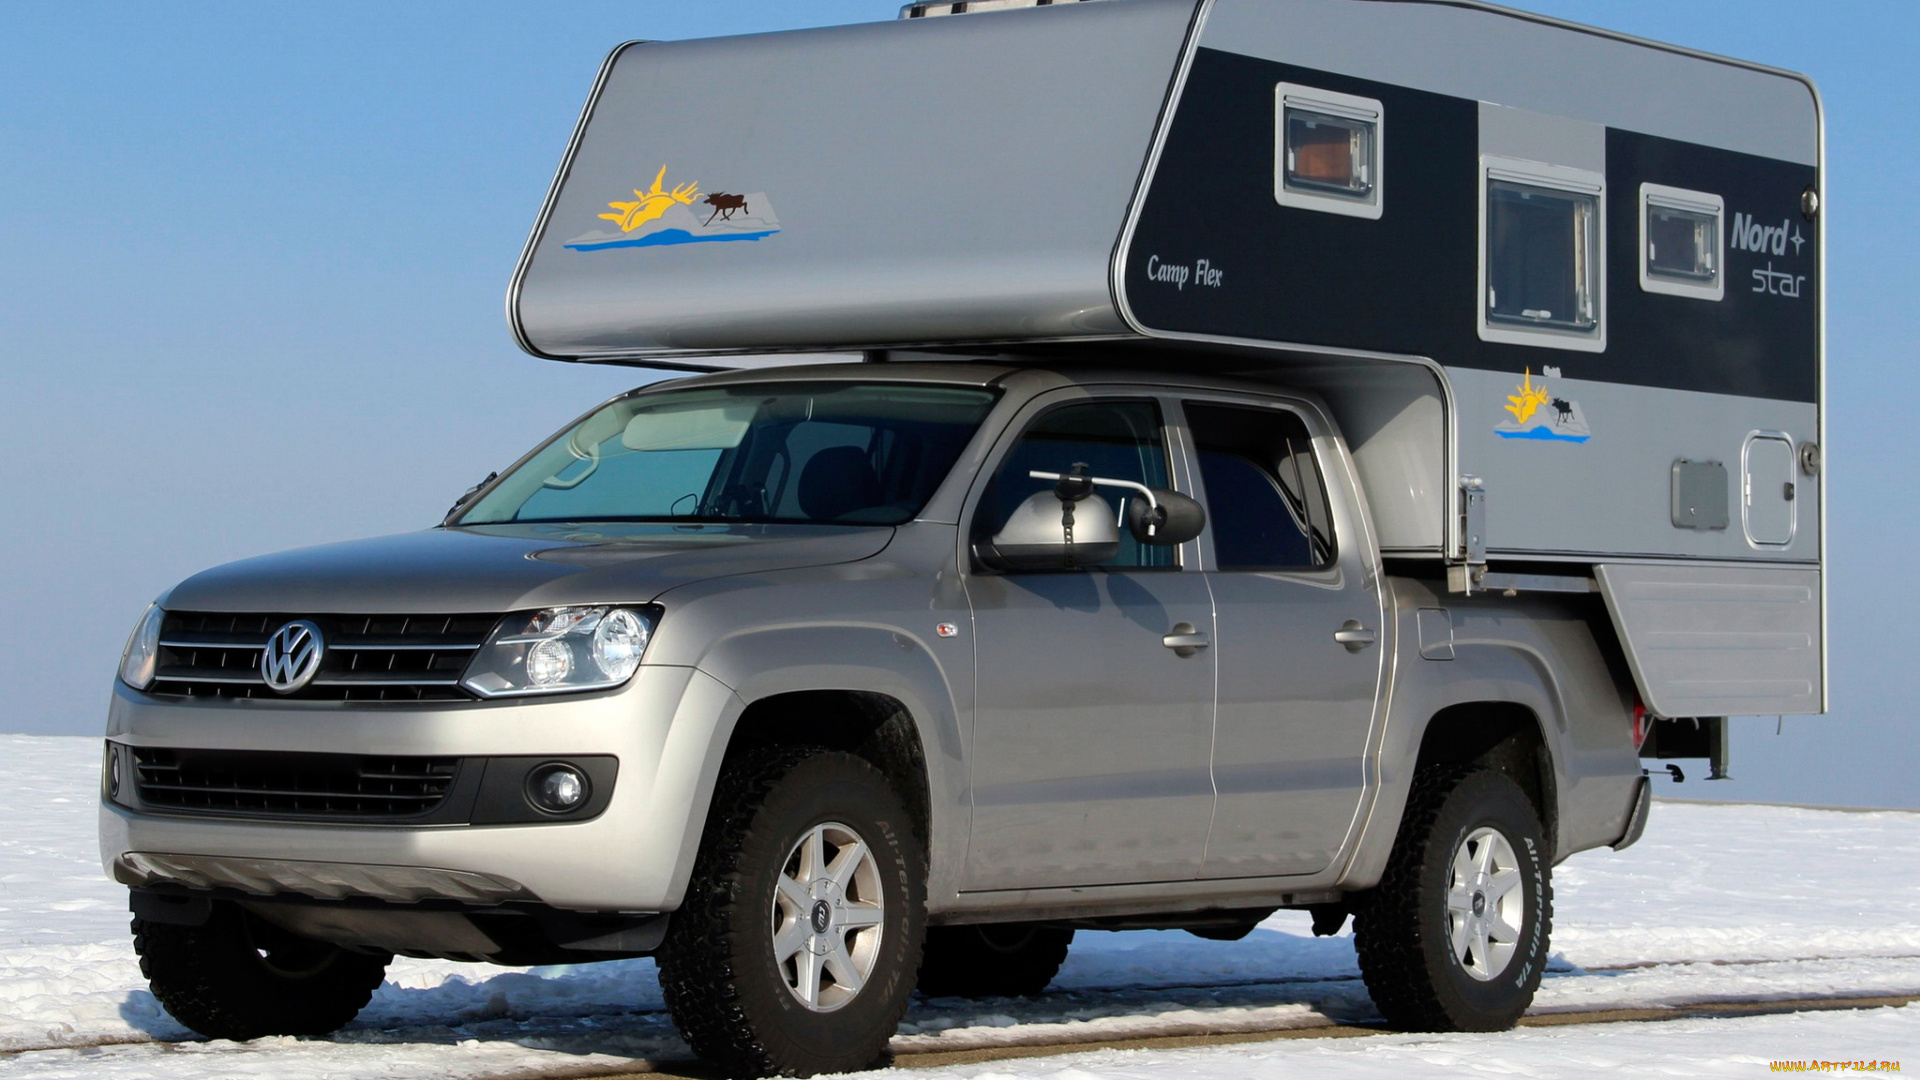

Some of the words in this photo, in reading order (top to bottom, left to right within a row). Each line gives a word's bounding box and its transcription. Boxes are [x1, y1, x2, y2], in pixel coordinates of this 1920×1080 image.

[1731, 212, 1790, 256] Nord
[1147, 254, 1189, 291] Camp
[1195, 258, 1223, 288] Flex
[1752, 261, 1806, 298] star
[265, 622, 319, 688] VW
[1523, 836, 1543, 960] All-Terrain
